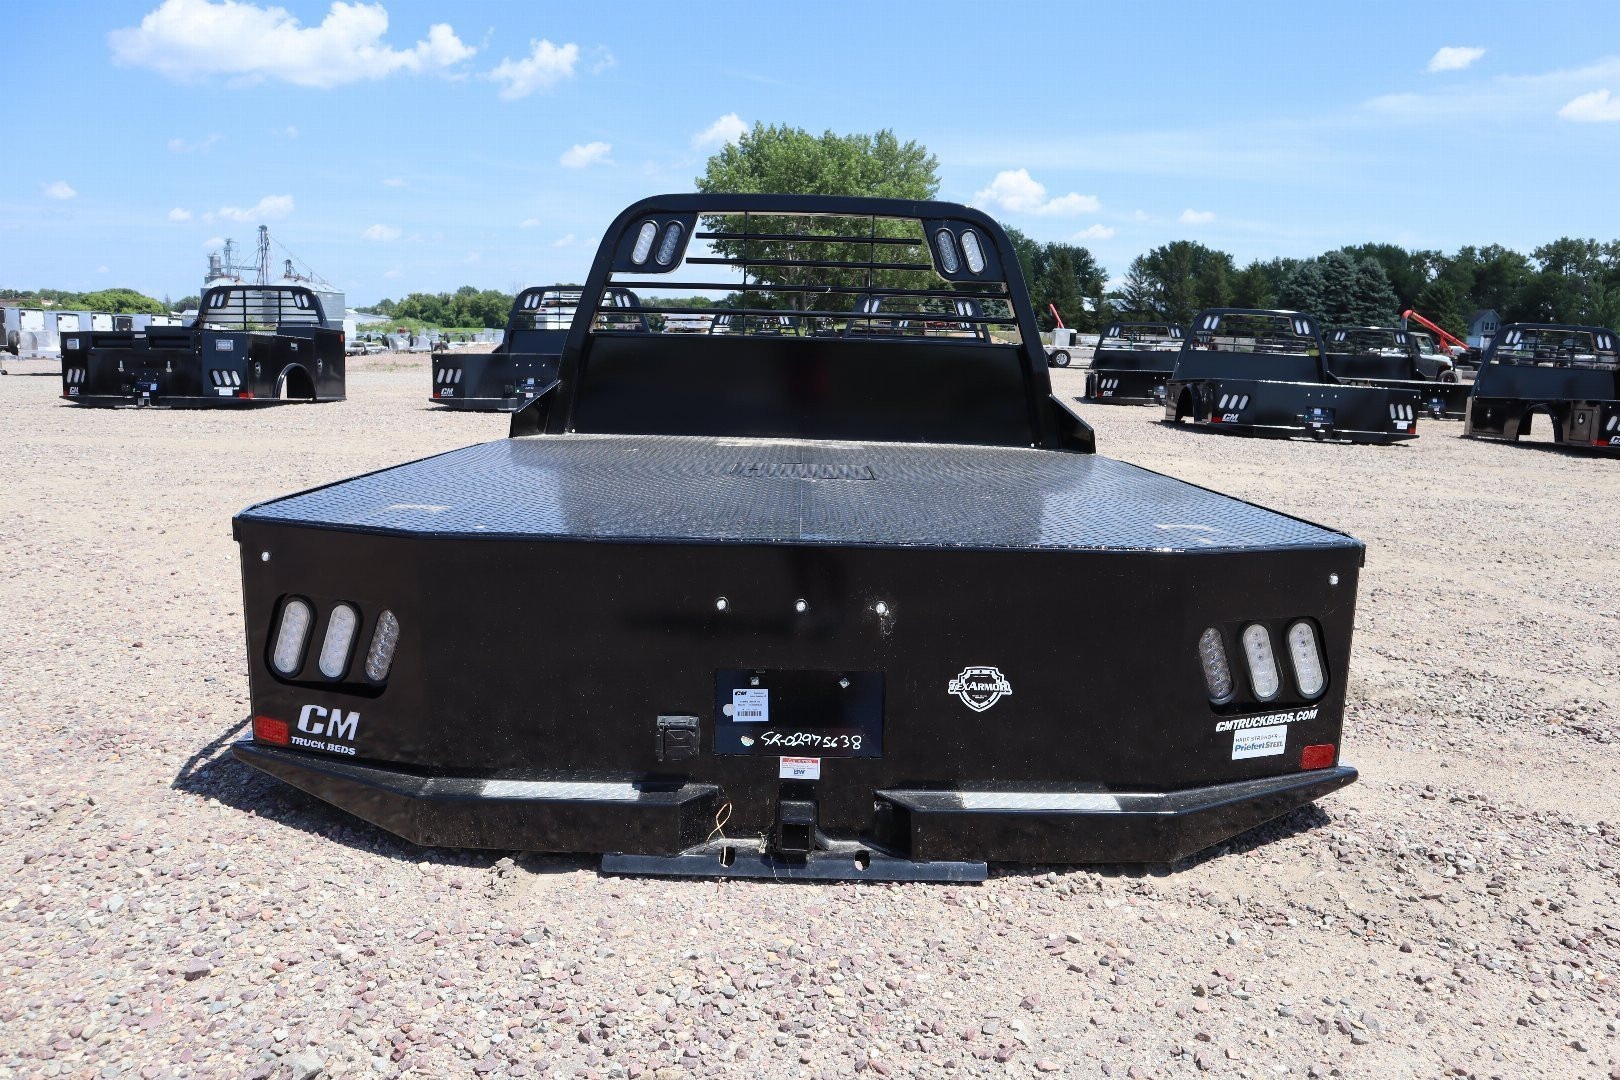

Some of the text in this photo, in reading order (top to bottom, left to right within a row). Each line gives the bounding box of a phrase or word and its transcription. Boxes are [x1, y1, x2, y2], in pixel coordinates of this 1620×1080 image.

[1222, 413, 1240, 421] CM
[297, 704, 360, 741] CM
[1216, 709, 1318, 732] CMTRUCKBEDS.COM
[291, 736, 356, 756] TRUCK BEDS
